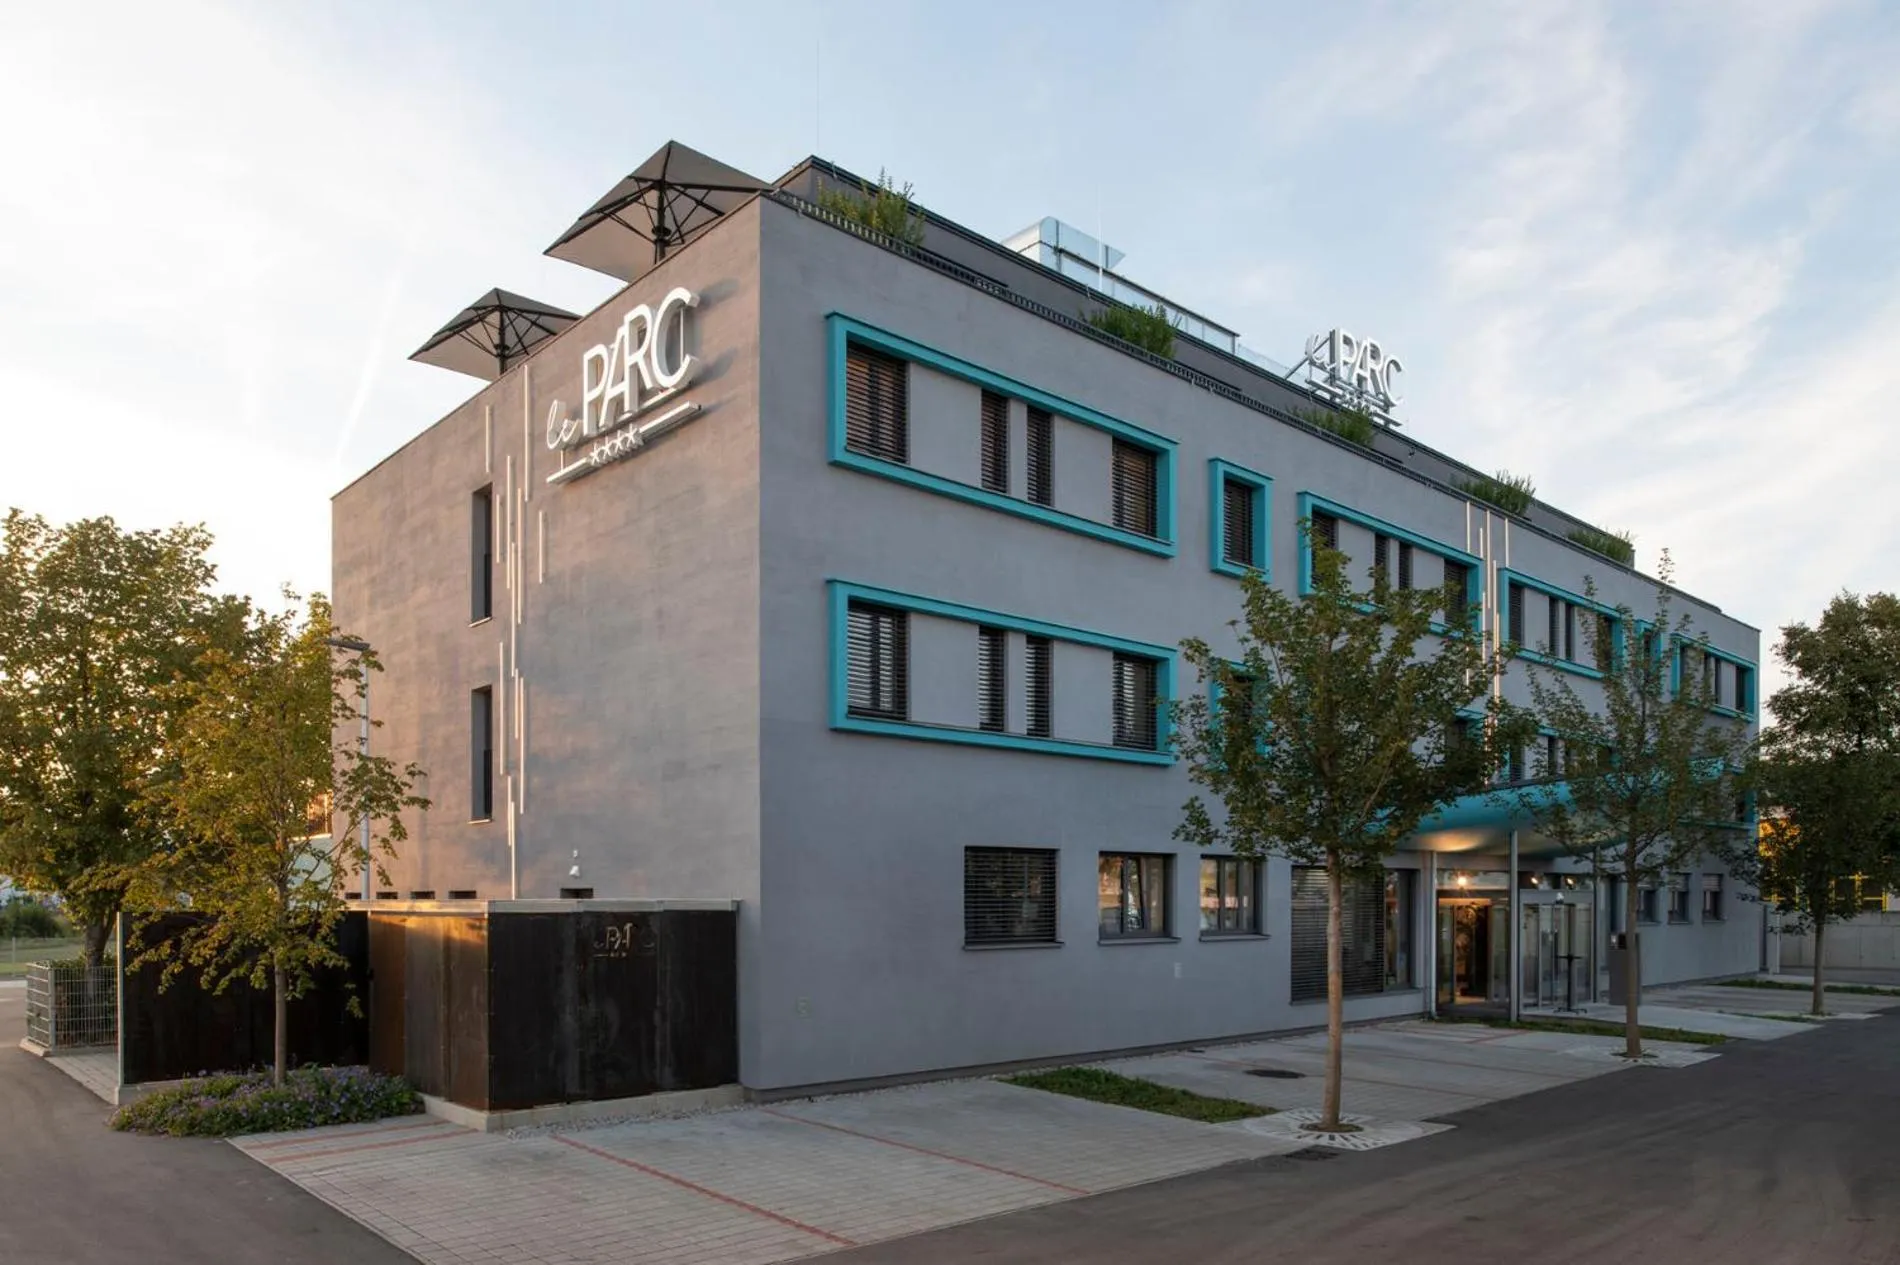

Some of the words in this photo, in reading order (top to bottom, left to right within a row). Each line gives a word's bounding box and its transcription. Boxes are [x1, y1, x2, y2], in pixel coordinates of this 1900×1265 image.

[546, 399, 580, 449] le
[583, 287, 699, 436] PARC
[1335, 328, 1403, 405] PARC
